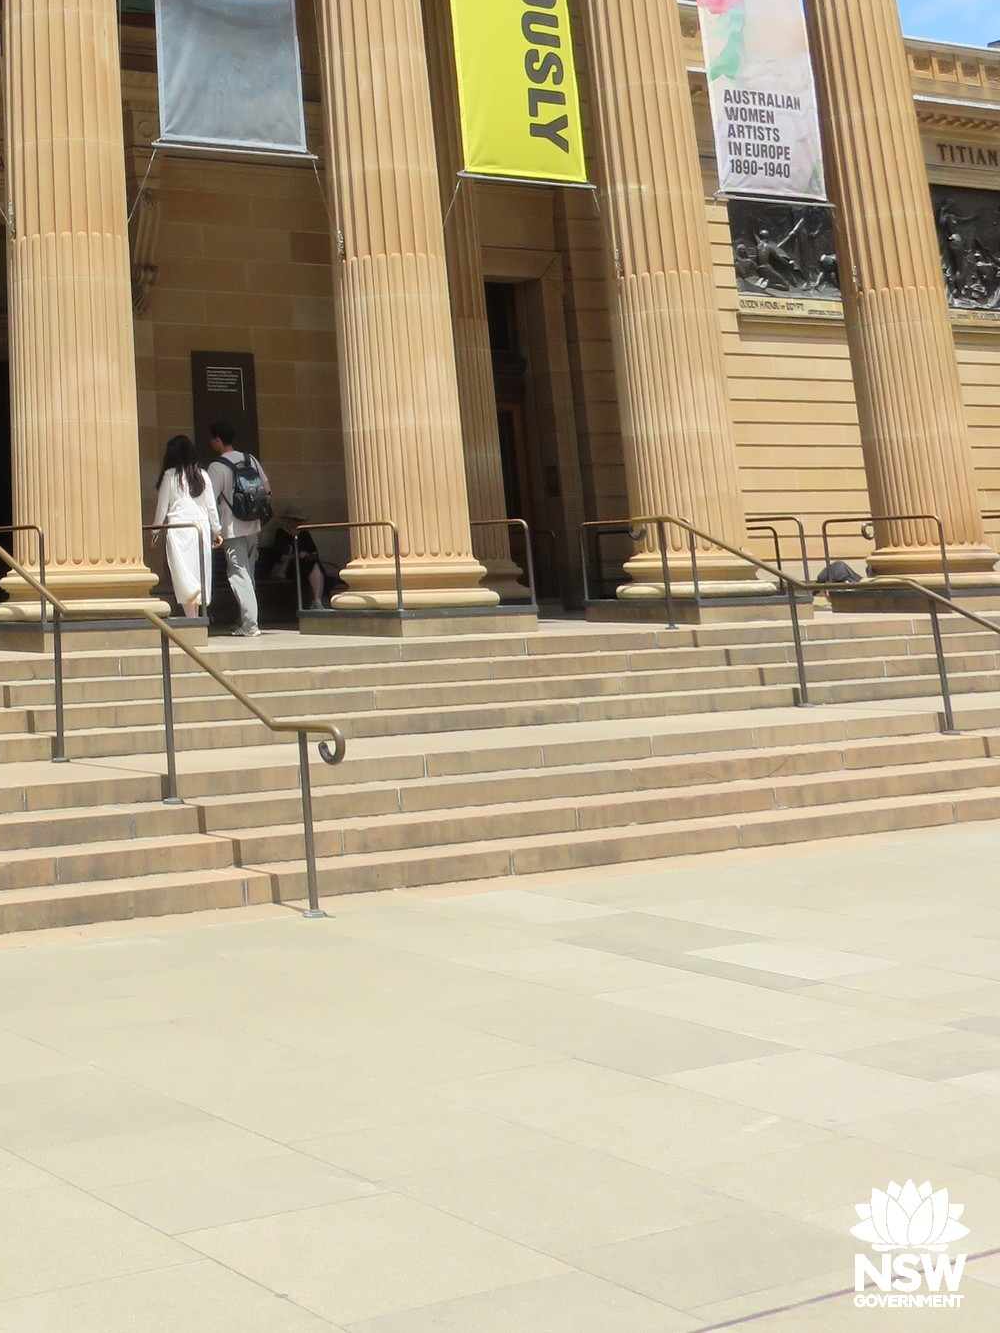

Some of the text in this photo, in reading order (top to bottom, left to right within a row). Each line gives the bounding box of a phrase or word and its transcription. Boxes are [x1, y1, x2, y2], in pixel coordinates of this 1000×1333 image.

[723, 89, 801, 111] AUSTRALIAN
[724, 106, 775, 124] WOMEN
[727, 123, 781, 142] ARTISTS
[728, 141, 791, 160] IN EUROPE
[936, 143, 999, 167] TITIAN
